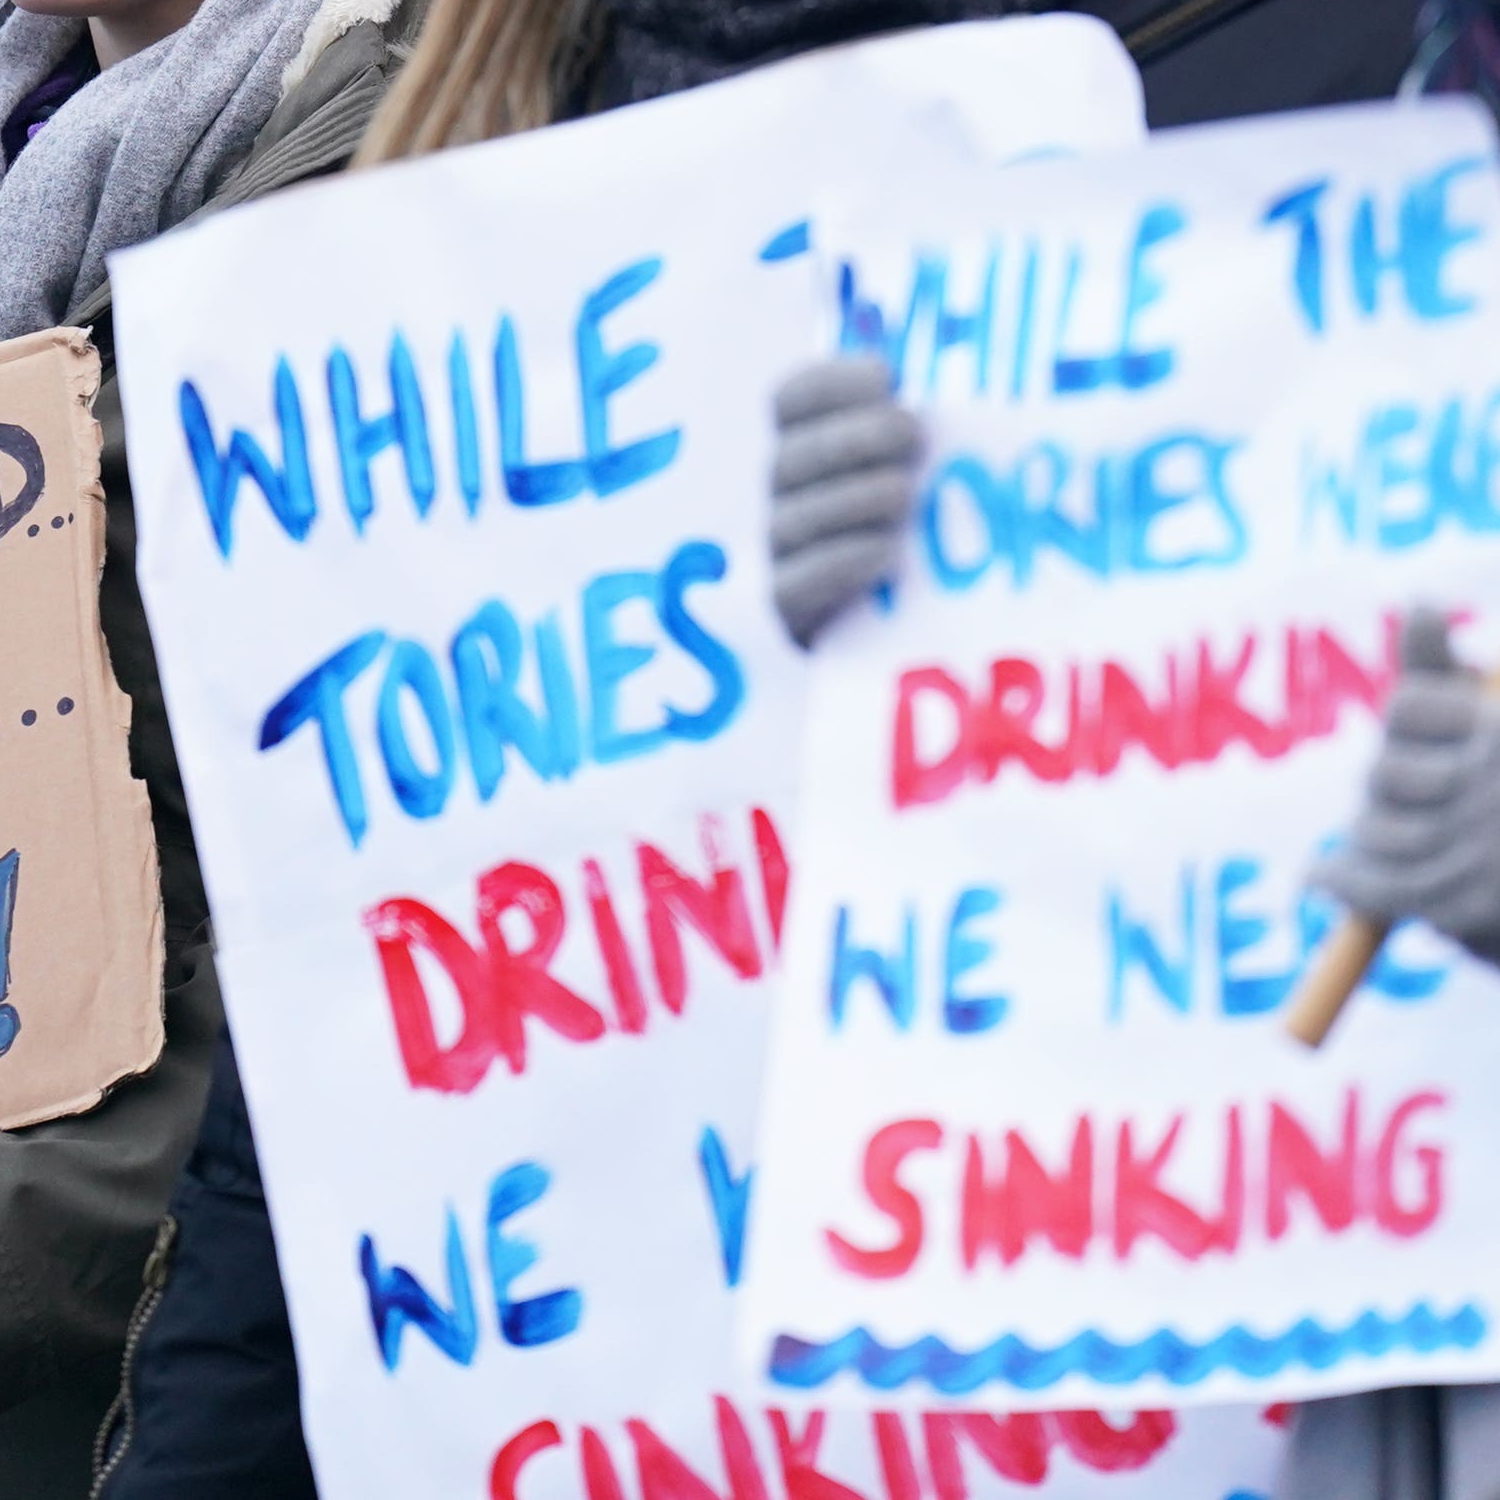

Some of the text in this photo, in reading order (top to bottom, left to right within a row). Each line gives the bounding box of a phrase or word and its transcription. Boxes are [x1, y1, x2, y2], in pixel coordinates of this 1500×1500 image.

[1262, 153, 1495, 338] THE
[178, 256, 684, 563] WHILE
[874, 428, 1255, 615] ORIES
[258, 540, 749, 850] TORIES
[890, 610, 1475, 812] DRINKIN
[828, 883, 1007, 1036] WE
[358, 1160, 585, 1374] WE
[825, 1088, 1445, 1282] SINKING
